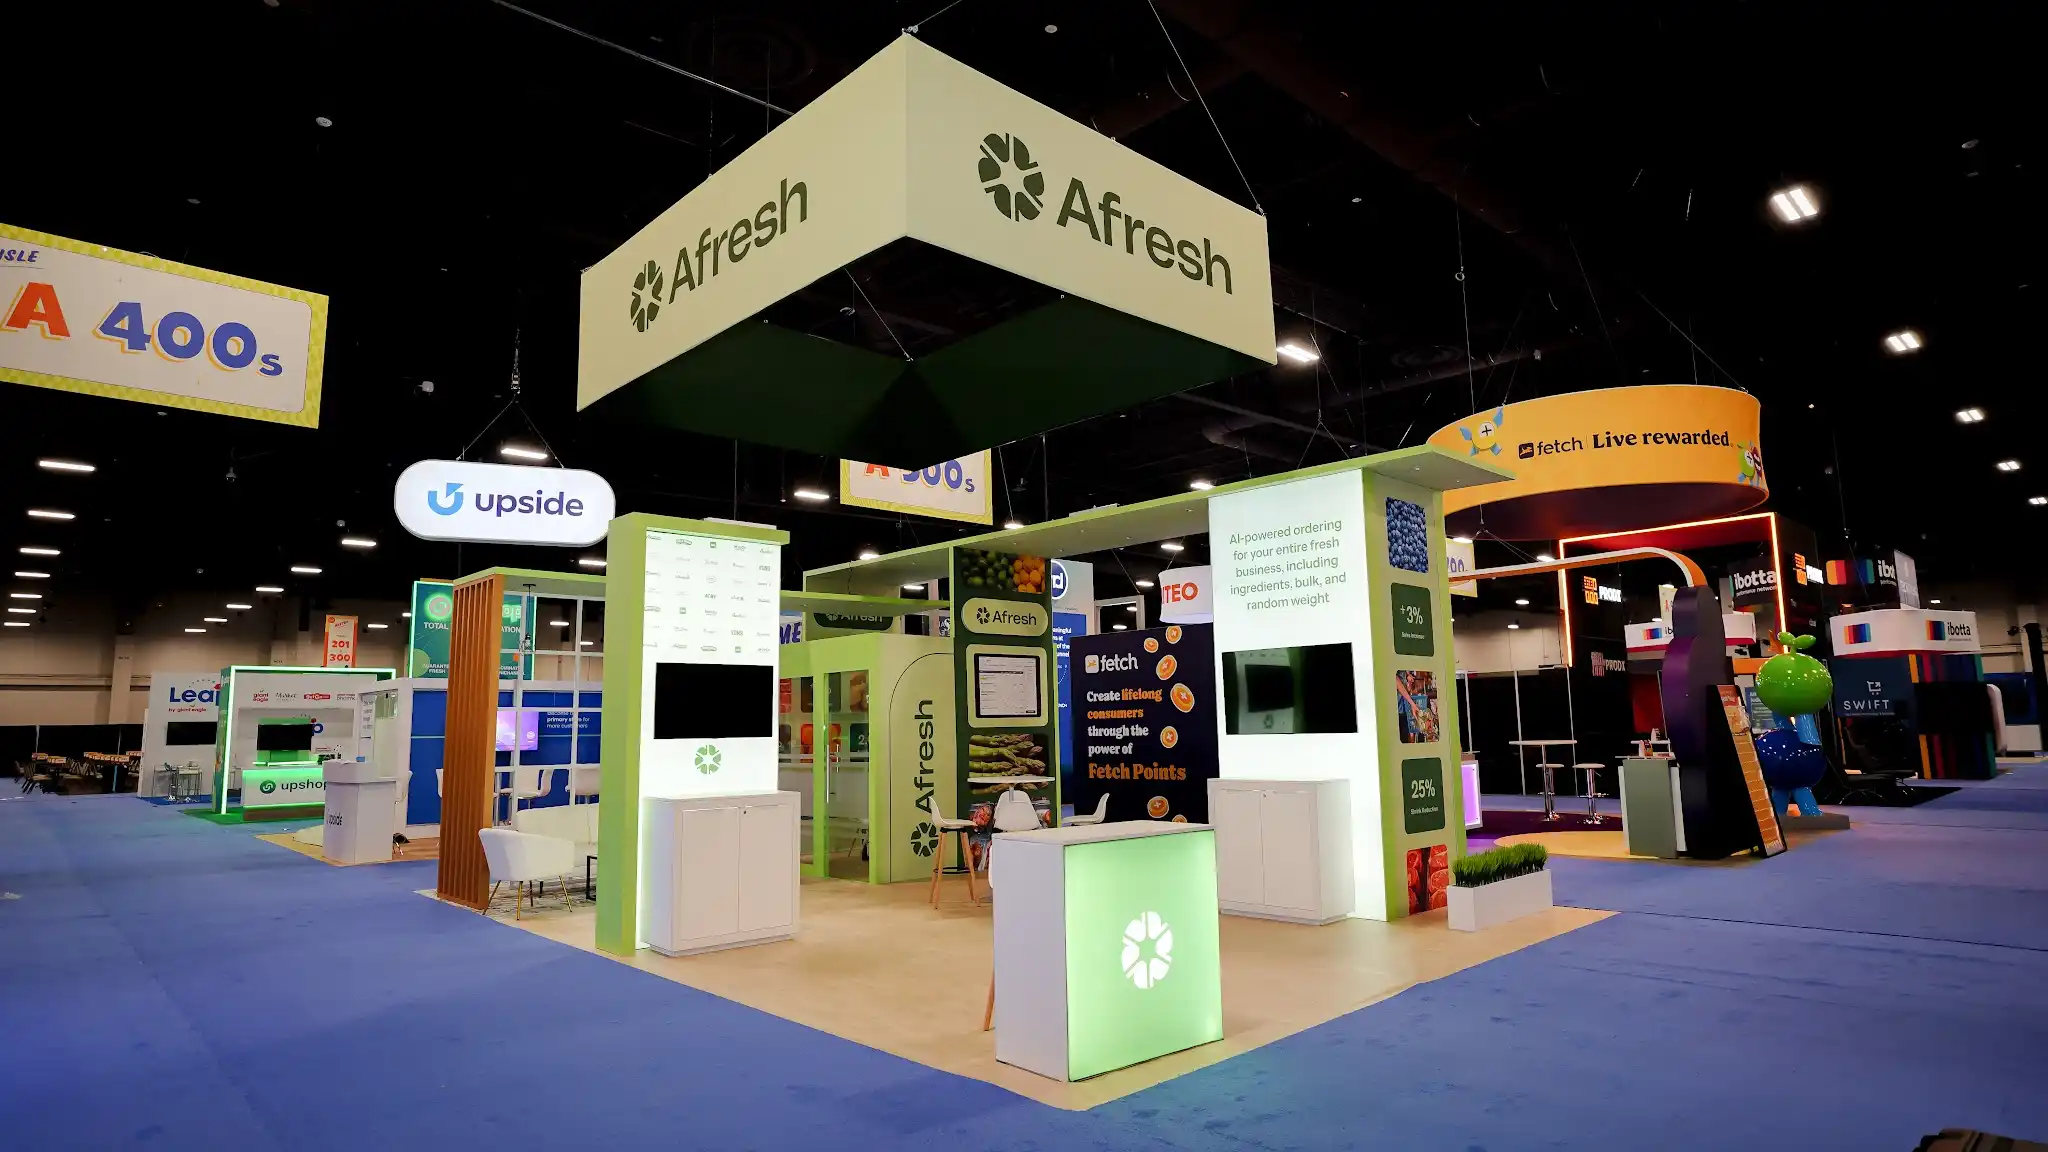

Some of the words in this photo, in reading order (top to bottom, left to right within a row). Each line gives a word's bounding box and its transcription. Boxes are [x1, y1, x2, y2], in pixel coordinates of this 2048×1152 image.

[668, 178, 808, 305] Afresh
[1057, 177, 1233, 295] Afresh
[5, 281, 71, 338] A
[98, 301, 283, 377] 400s
[1537, 437, 1583, 455] fetch
[1592, 431, 1637, 448] Live
[475, 489, 584, 517] upside
[1229, 526, 1291, 545] AI-powered
[1293, 520, 1342, 535] ordering
[1233, 551, 1248, 560] for
[1250, 547, 1274, 561] your
[1276, 542, 1308, 555] entire
[1310, 536, 1340, 550] fresh
[1236, 564, 1284, 577] business,
[1286, 556, 1339, 571] including
[1295, 575, 1322, 588] bulk,
[1325, 572, 1347, 584] and
[1733, 570, 1777, 590] ibotta
[1247, 597, 1289, 610] random
[1291, 592, 1330, 607] weight
[993, 610, 1037, 626] Afresh
[1400, 604, 1424, 625] +3%
[423, 622, 449, 630] TOTAL
[1947, 621, 1972, 635] ibotta
[332, 640, 350, 648] 201
[329, 653, 350, 661] 300
[1100, 653, 1138, 672] fetch
[1605, 660, 1626, 671] PRODX
[1087, 690, 1120, 702] Create
[1121, 688, 1163, 702] lifelong
[1087, 708, 1144, 719] consumers
[1843, 699, 1890, 711] SWIFT
[1087, 724, 1129, 739] through
[1130, 723, 1149, 736] the
[914, 699, 934, 815] Afresh
[1088, 744, 1120, 757] power
[1121, 742, 1133, 755] of
[1088, 762, 1130, 779] Fetch
[1132, 761, 1187, 780] Points
[1411, 778, 1436, 798] 25%
